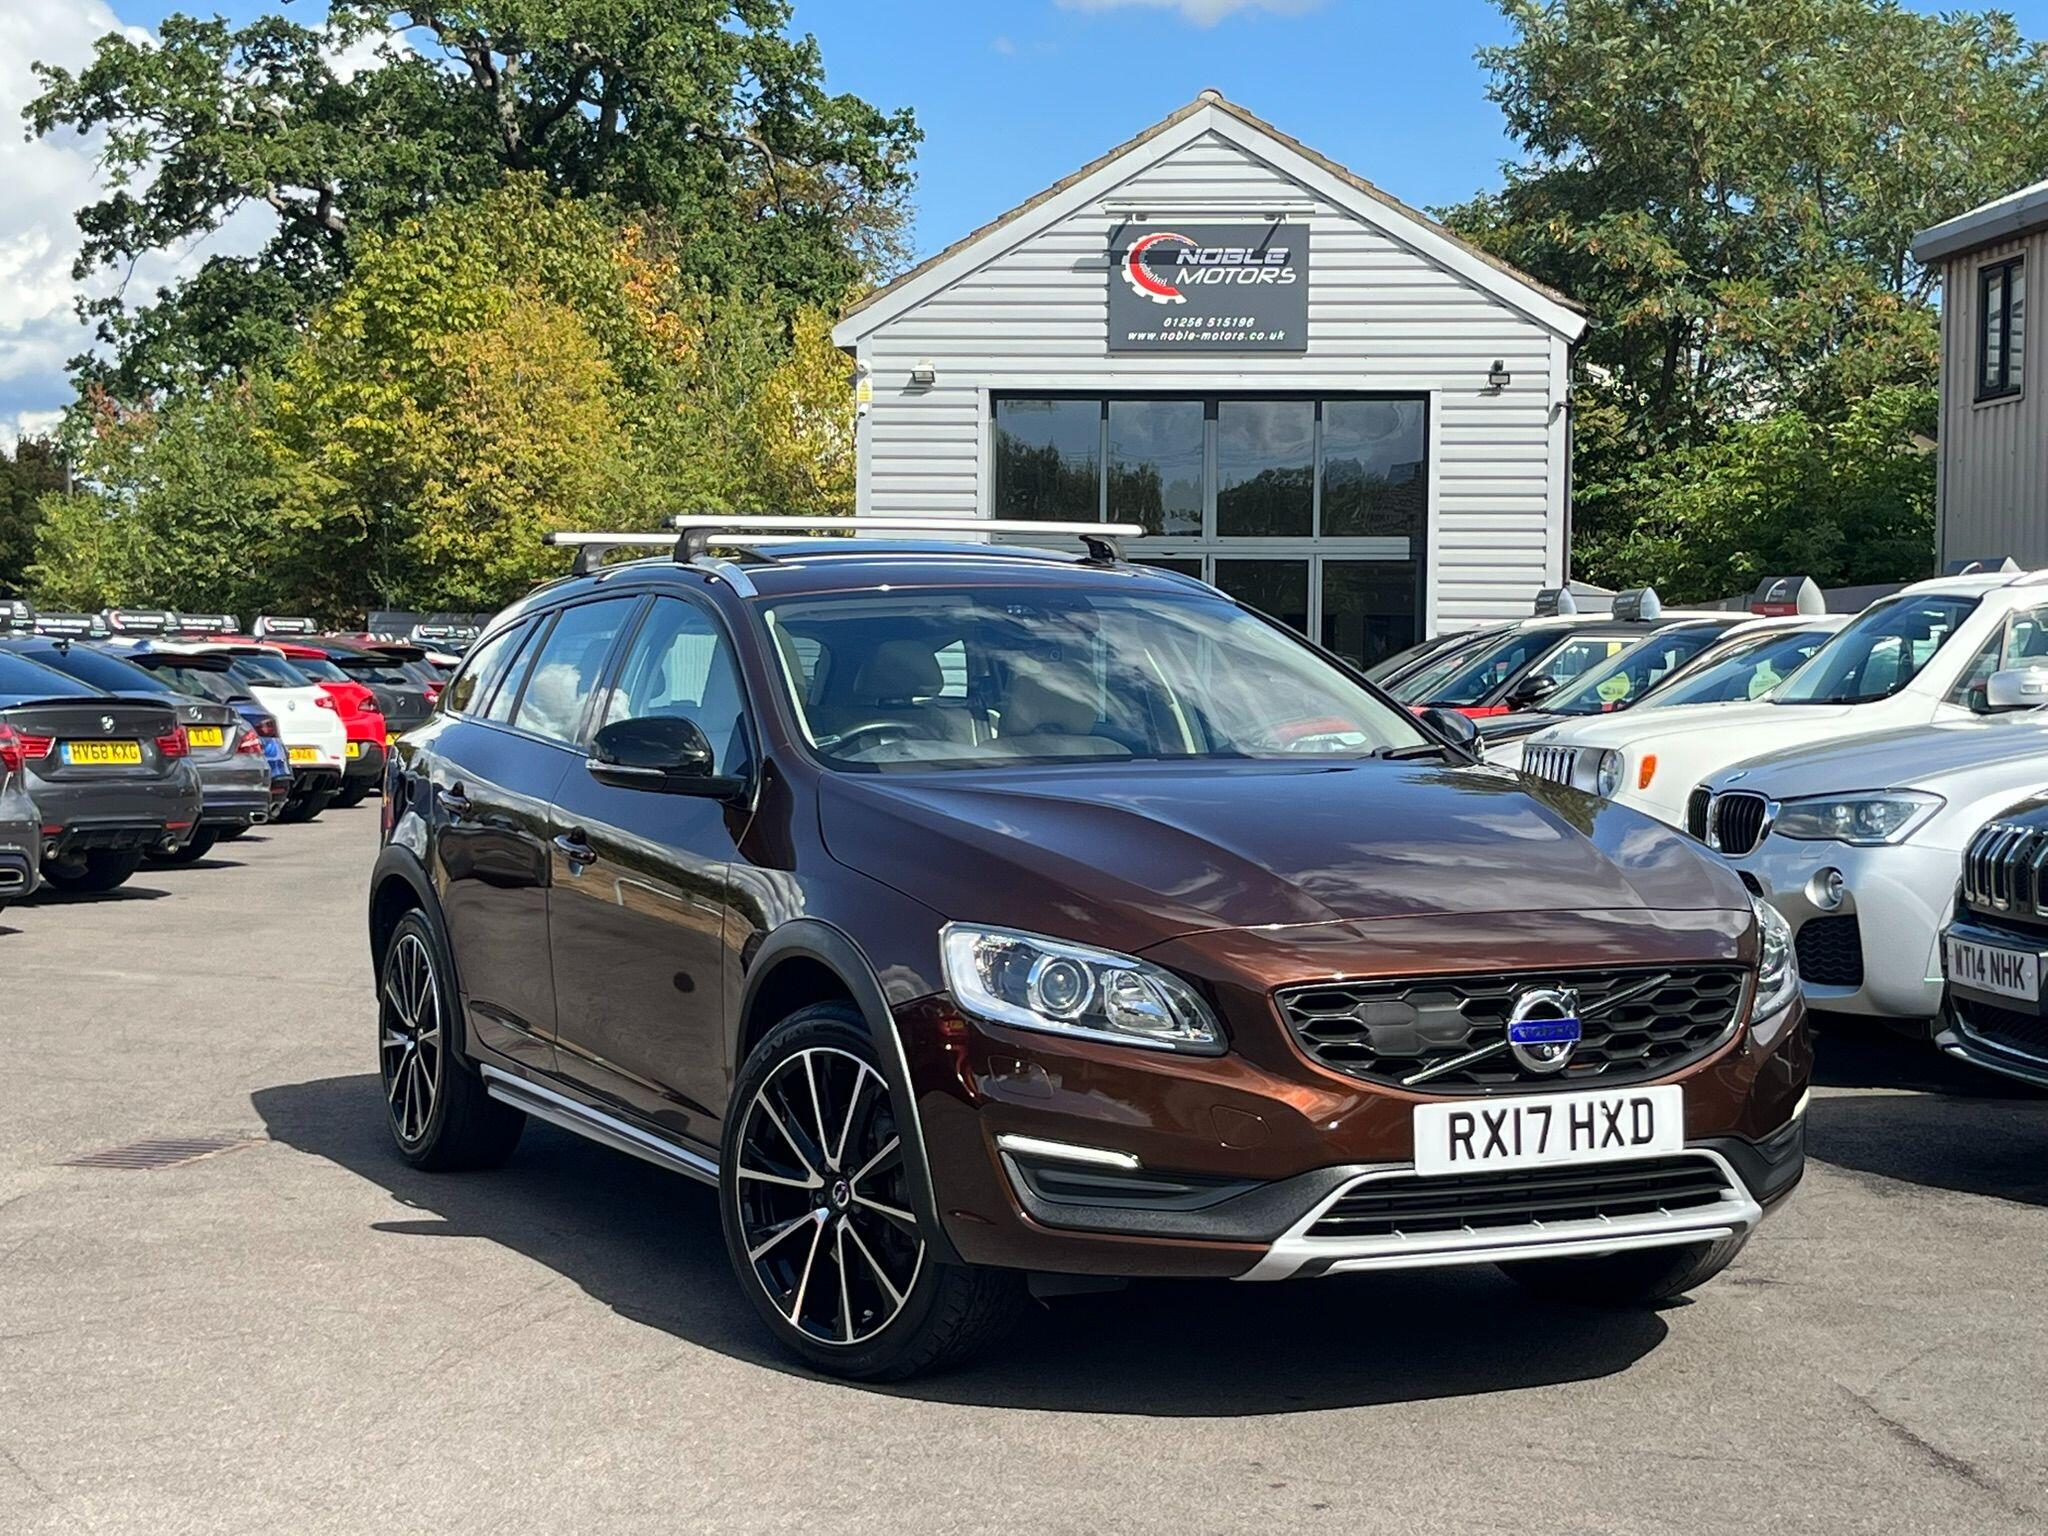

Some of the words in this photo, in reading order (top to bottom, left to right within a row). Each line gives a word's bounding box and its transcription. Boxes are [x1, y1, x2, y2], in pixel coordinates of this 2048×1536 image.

[1176, 247, 1289, 265] NOBLE
[1175, 267, 1297, 284] MOTORS
[1127, 330, 1285, 341] www.noble-motors.co.uk
[73, 743, 107, 760] HV68
[1990, 951, 2025, 991] NHK
[1449, 1105, 1552, 1161] RX17
[1569, 1097, 1655, 1151] HXD
